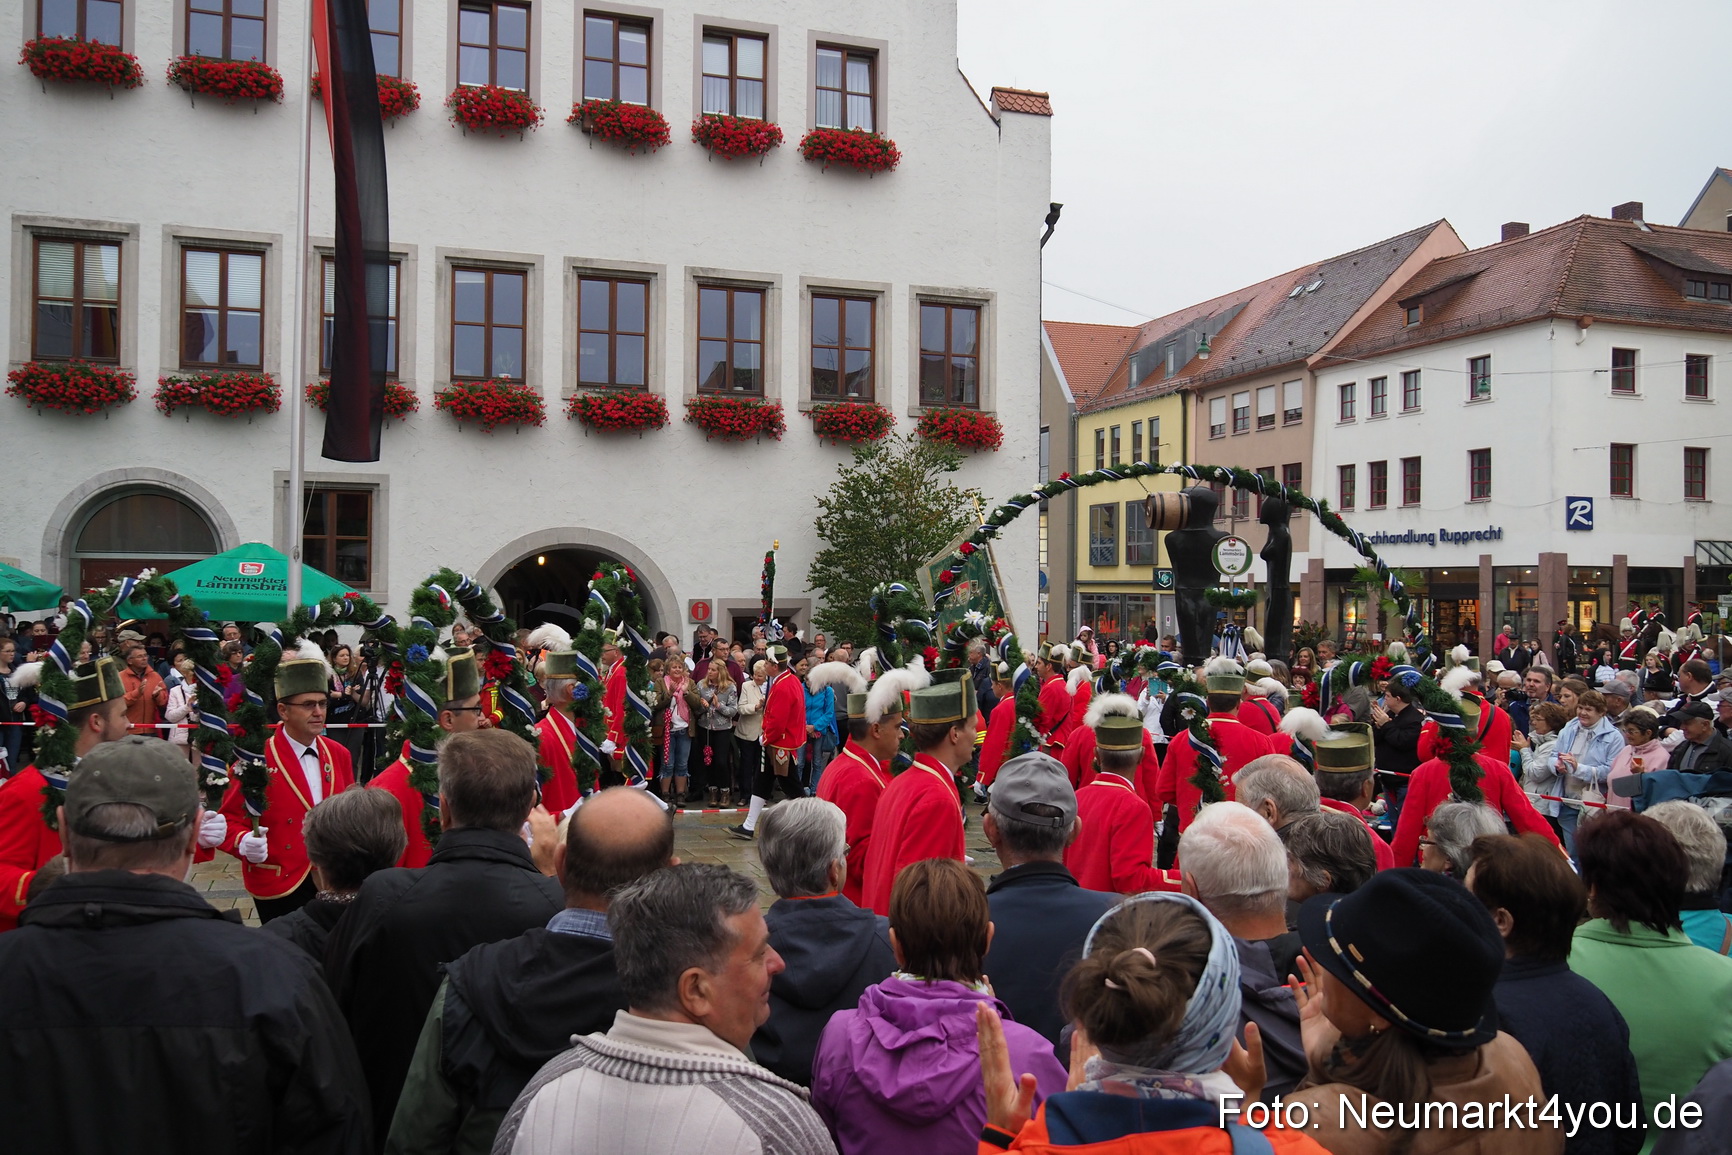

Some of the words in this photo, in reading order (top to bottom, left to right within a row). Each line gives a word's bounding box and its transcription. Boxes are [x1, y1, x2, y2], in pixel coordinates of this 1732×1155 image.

[1439, 525, 1502, 544] Rupprecht
[196, 579, 287, 591] Lammsbrä
[213, 575, 286, 584] Neumarkter
